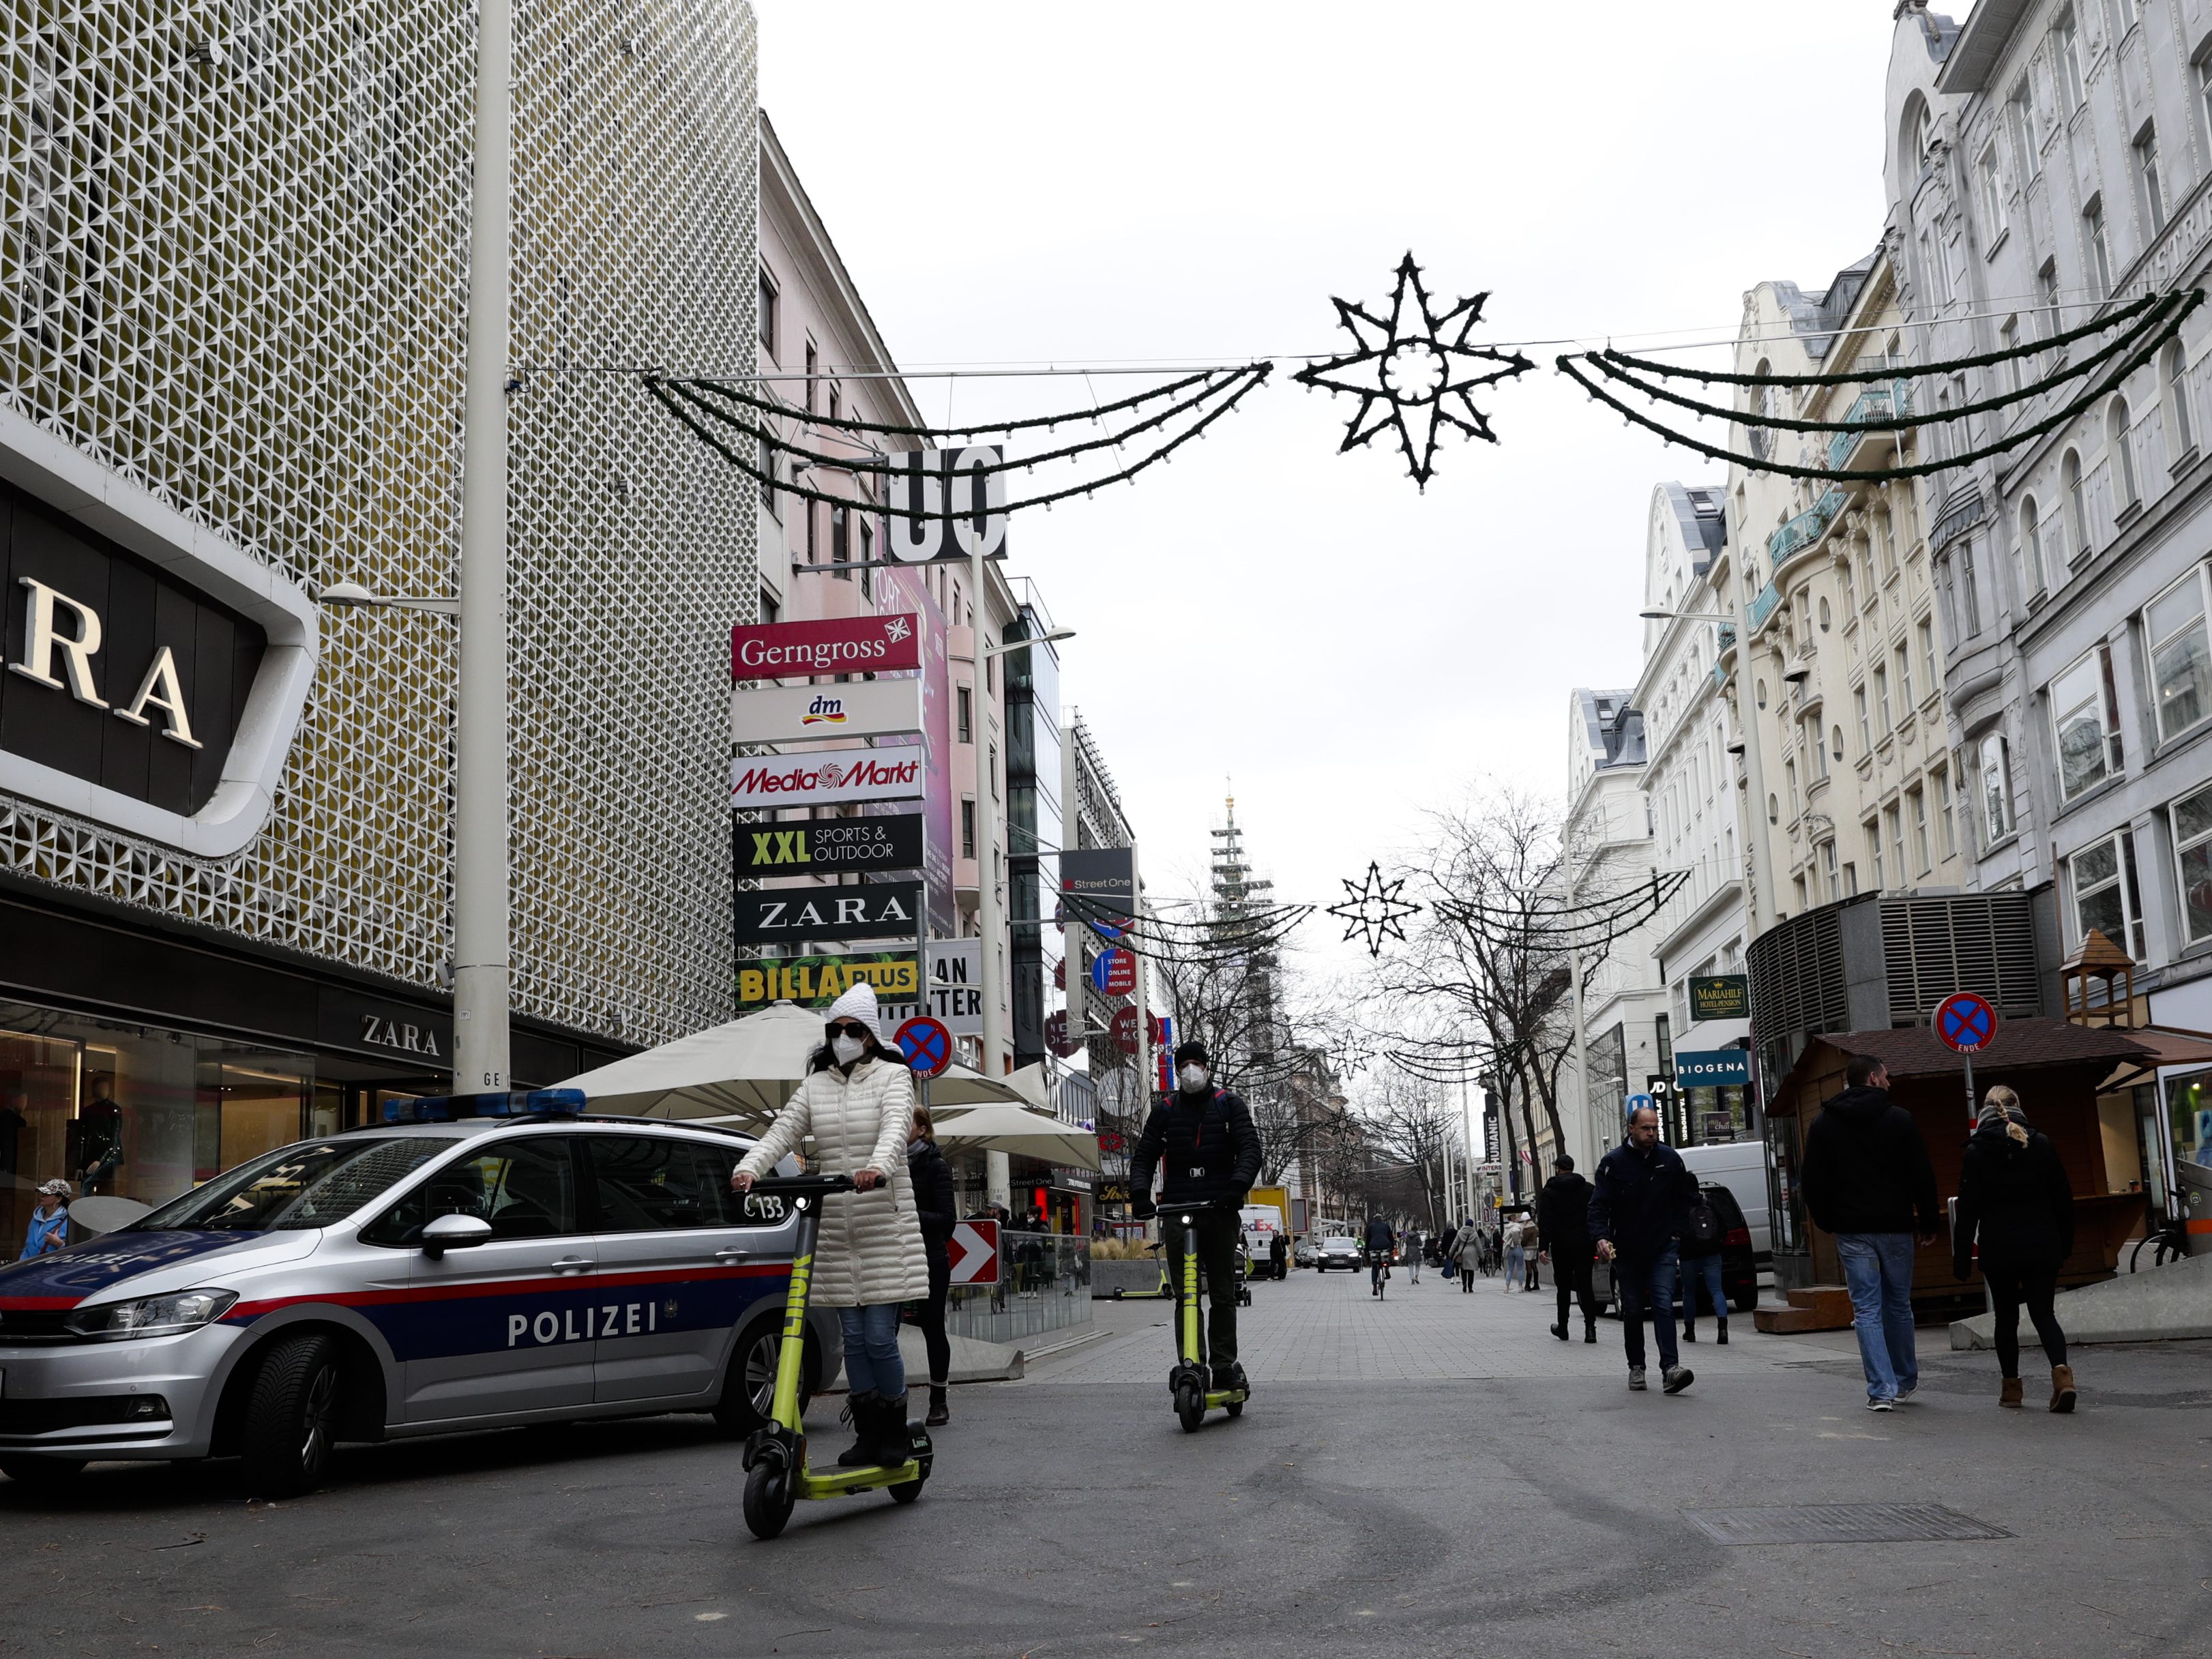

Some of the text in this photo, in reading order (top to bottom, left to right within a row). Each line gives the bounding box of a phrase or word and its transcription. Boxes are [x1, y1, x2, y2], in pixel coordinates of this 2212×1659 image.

[890, 445, 1005, 562] UO
[0, 576, 204, 750] RA
[741, 637, 885, 669] Gerngross
[809, 694, 842, 714] dm
[751, 826, 886, 866] XXL SPORTS &
[814, 843, 894, 862] OUTDOOR
[1074, 878, 1131, 889] Street One
[758, 896, 913, 929] ZARA
[740, 967, 911, 1001] BILLA PLUS
[1698, 988, 1742, 1000] MARIAHILF
[361, 1014, 440, 1057] ZARA
[1958, 1043, 1980, 1052] ENDE
[1679, 1061, 1745, 1074] BIOGENA
[1650, 1081, 1666, 1093] JD
[1488, 1116, 1501, 1164] HUMANIC
[755, 1195, 784, 1219] 133
[1241, 1218, 1273, 1232] edEx
[508, 1302, 656, 1346] POLIZEI
